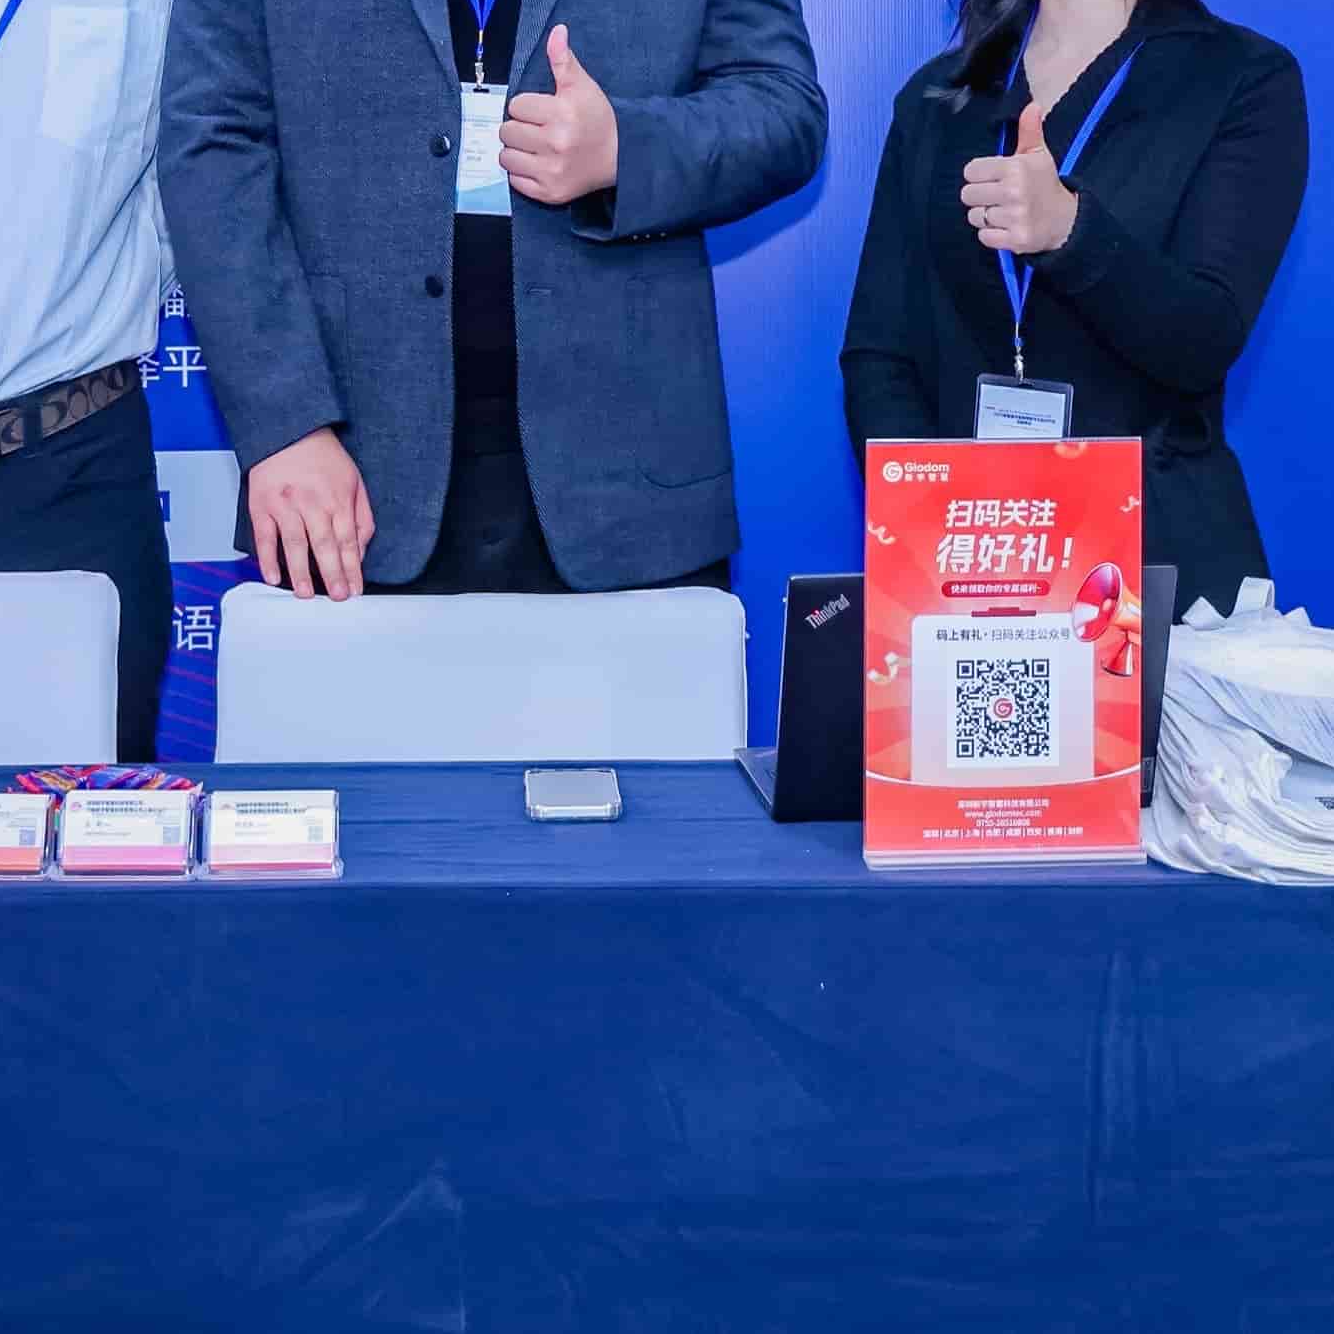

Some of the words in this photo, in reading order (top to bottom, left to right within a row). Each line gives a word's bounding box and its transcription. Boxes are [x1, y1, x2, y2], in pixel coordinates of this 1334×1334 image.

[945, 499, 1058, 528] 扫码关注
[173, 604, 216, 650] 语
